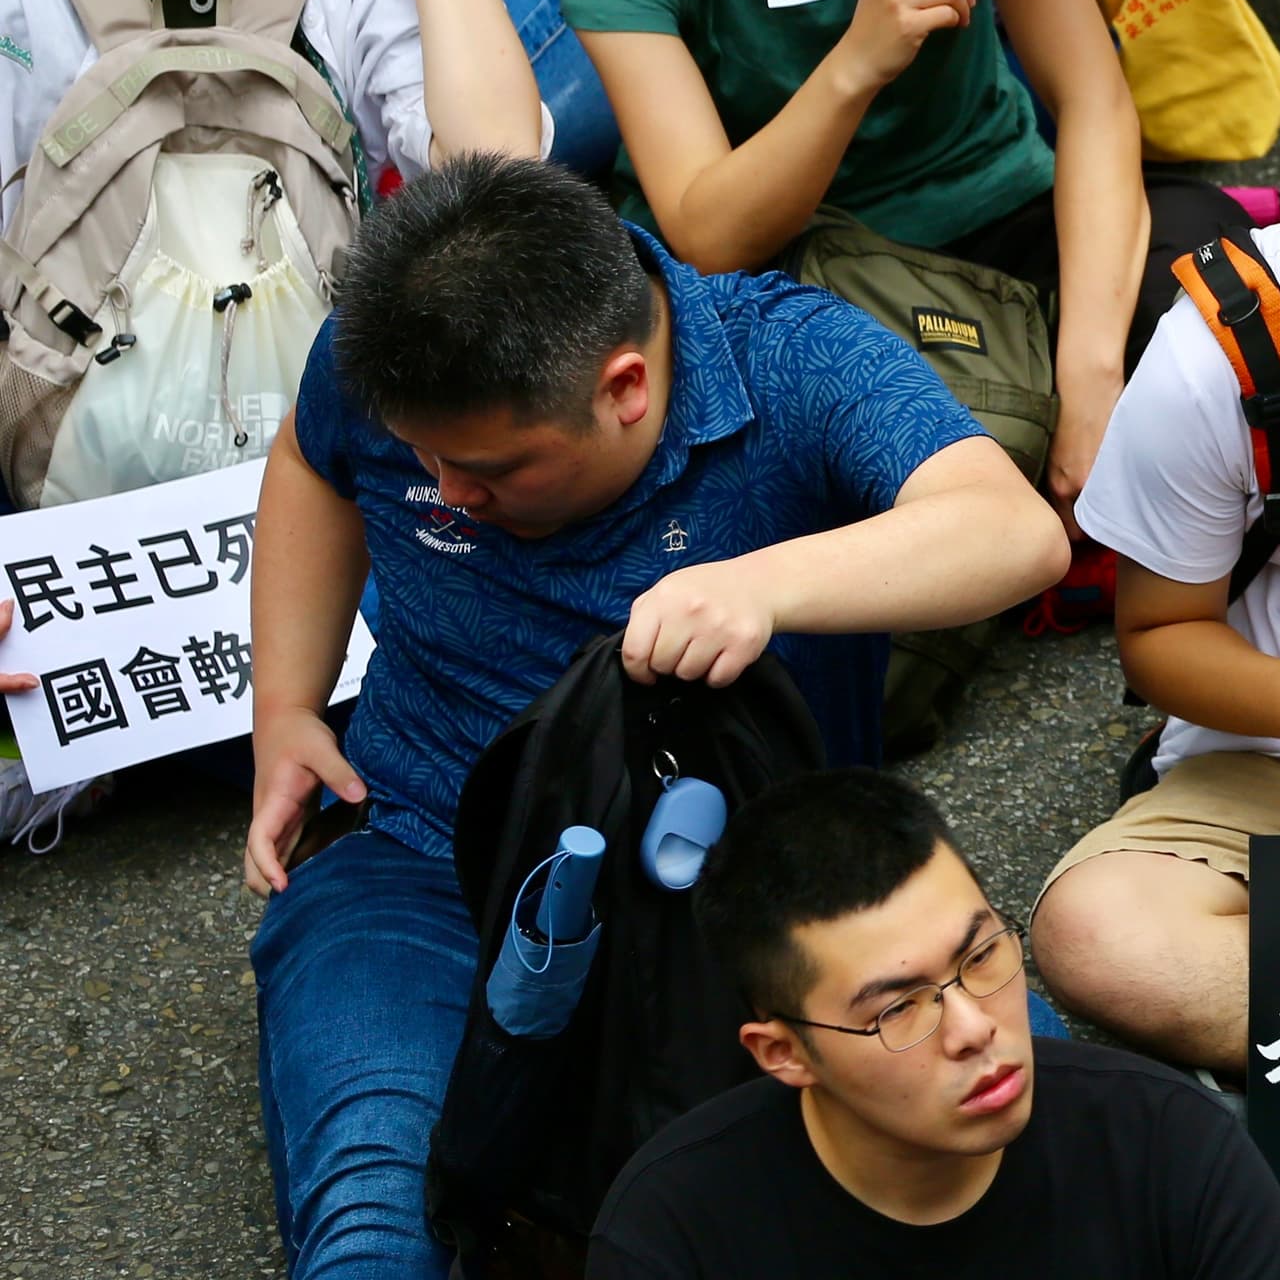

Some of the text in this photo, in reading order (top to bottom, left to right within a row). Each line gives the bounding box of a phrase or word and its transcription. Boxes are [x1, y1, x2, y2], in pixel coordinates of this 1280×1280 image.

[918, 314, 979, 340] PALLADIUM
[39, 631, 253, 747] 國會輓
